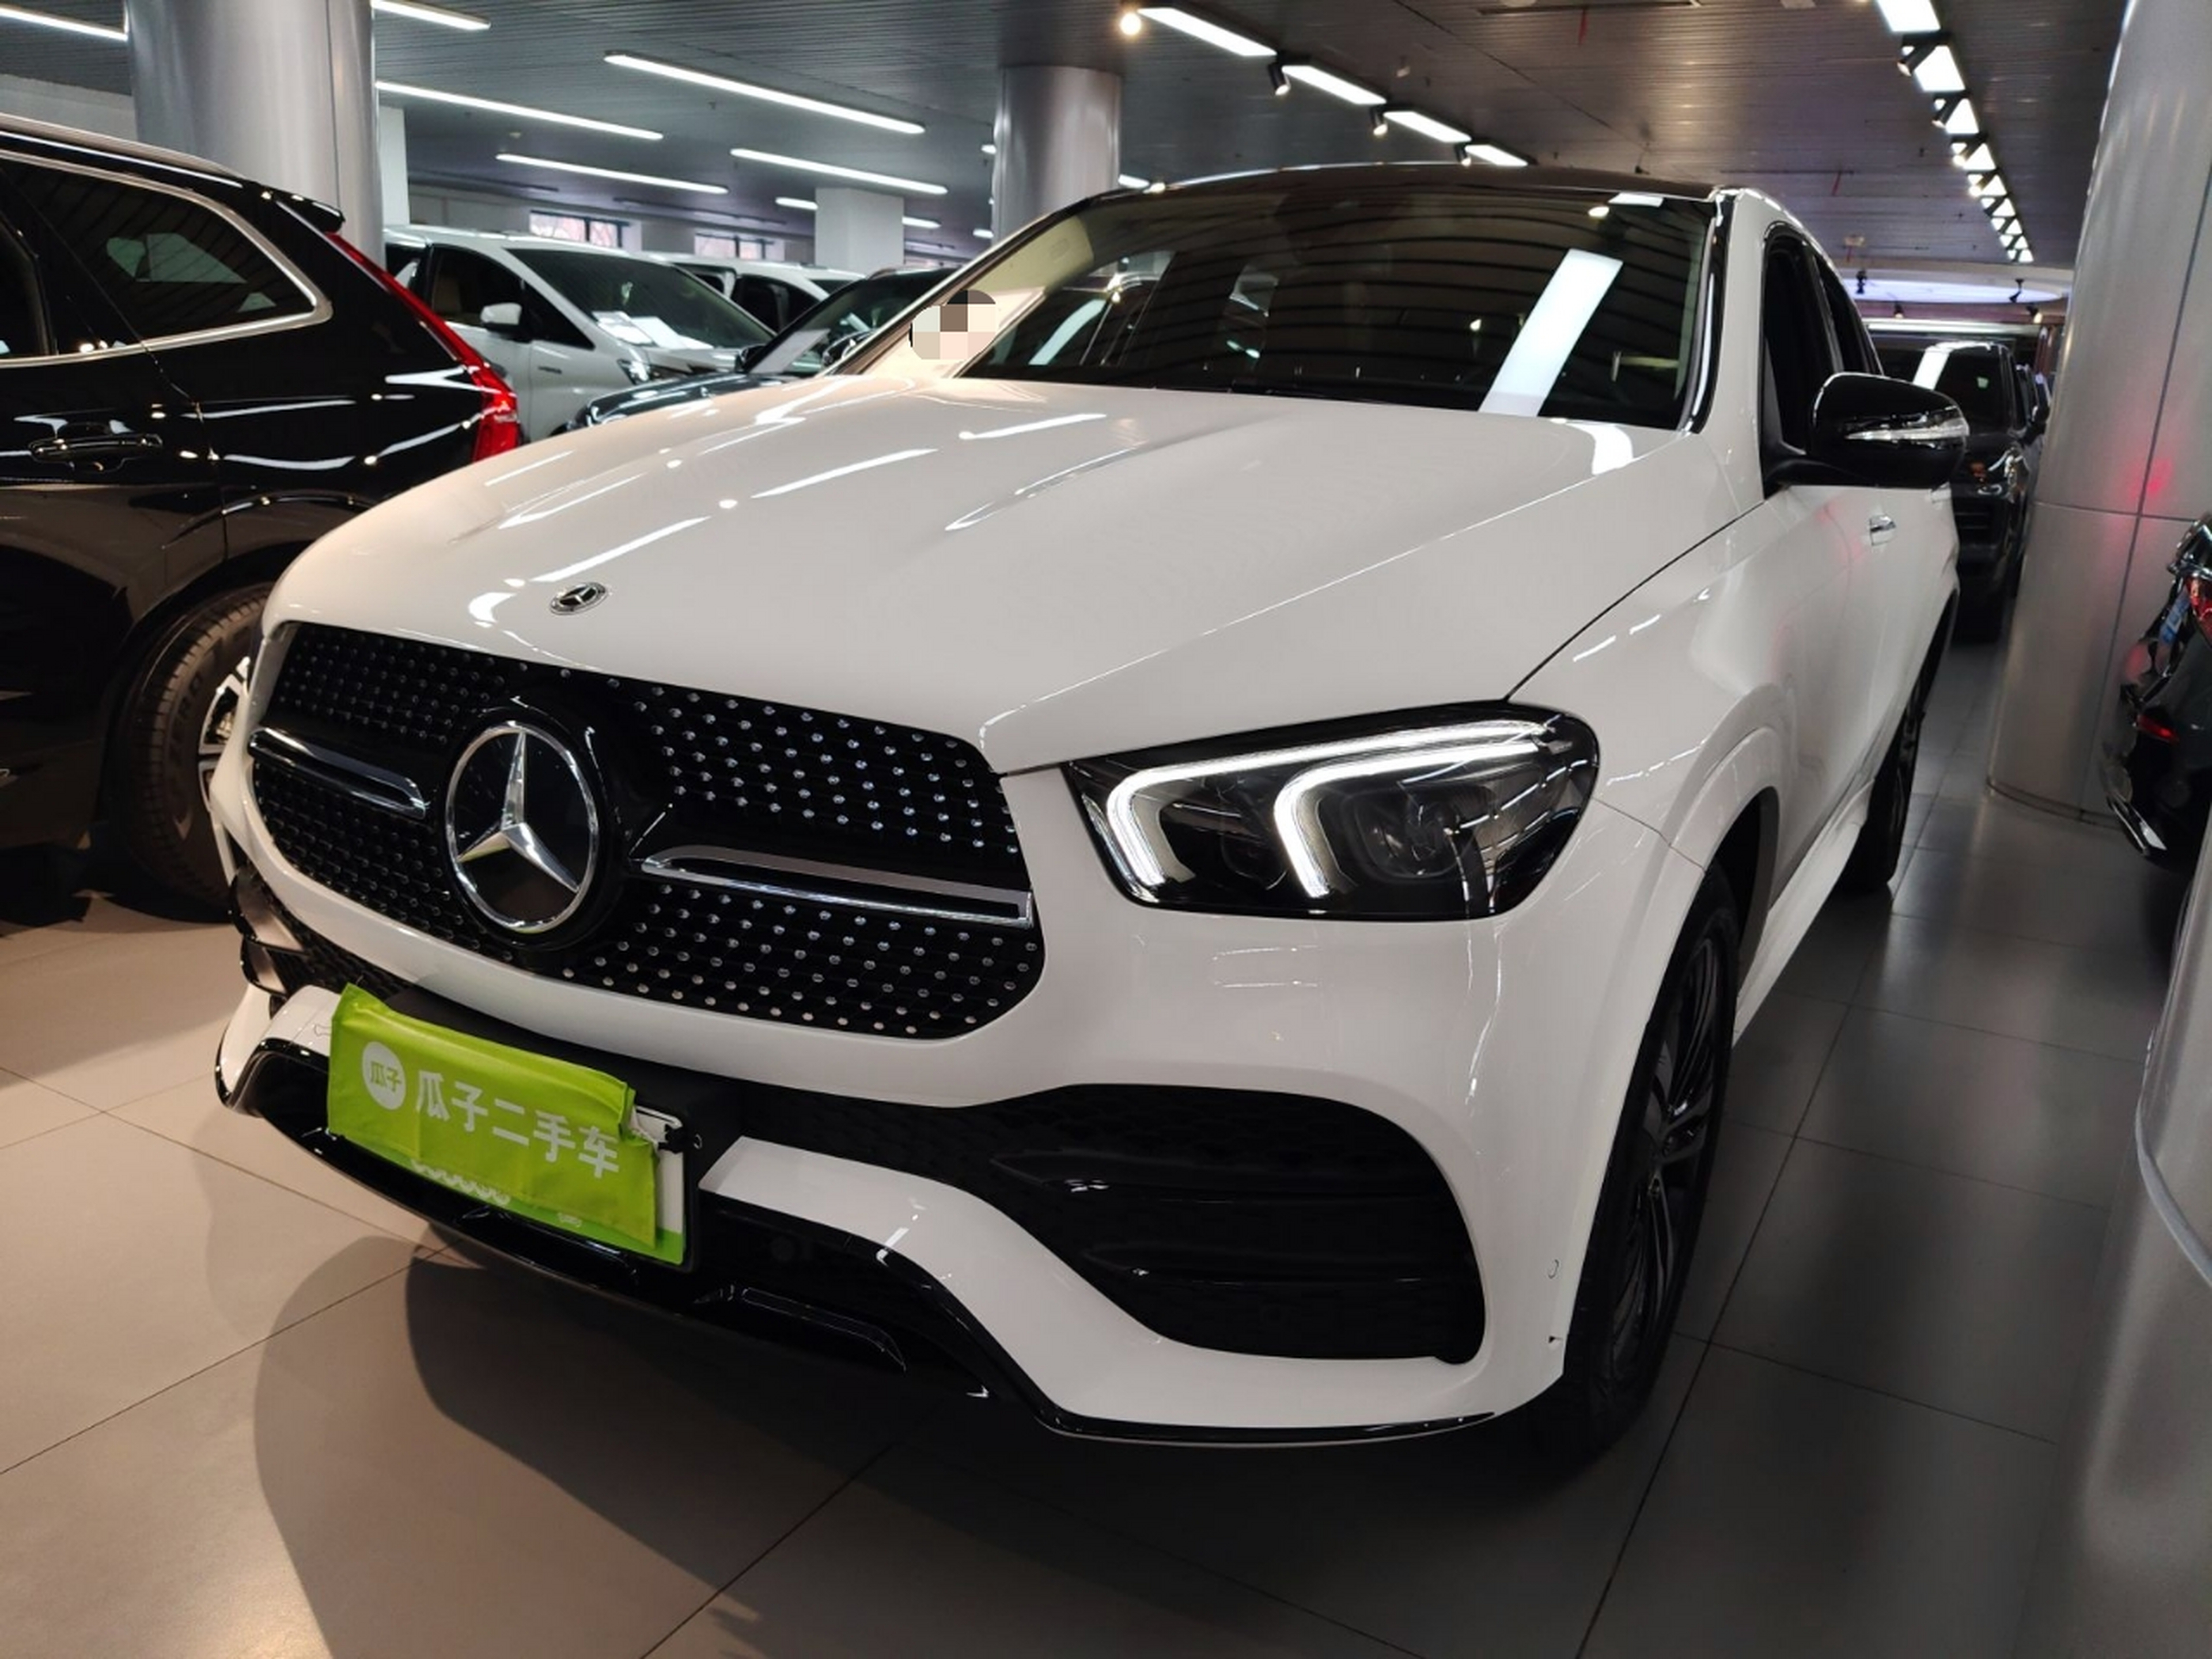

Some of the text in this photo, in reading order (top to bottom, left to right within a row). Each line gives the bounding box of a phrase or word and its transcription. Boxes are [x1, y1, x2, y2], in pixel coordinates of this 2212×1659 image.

[370, 1060, 402, 1092] 瓜子
[416, 1070, 619, 1179] 瓜子二手车
